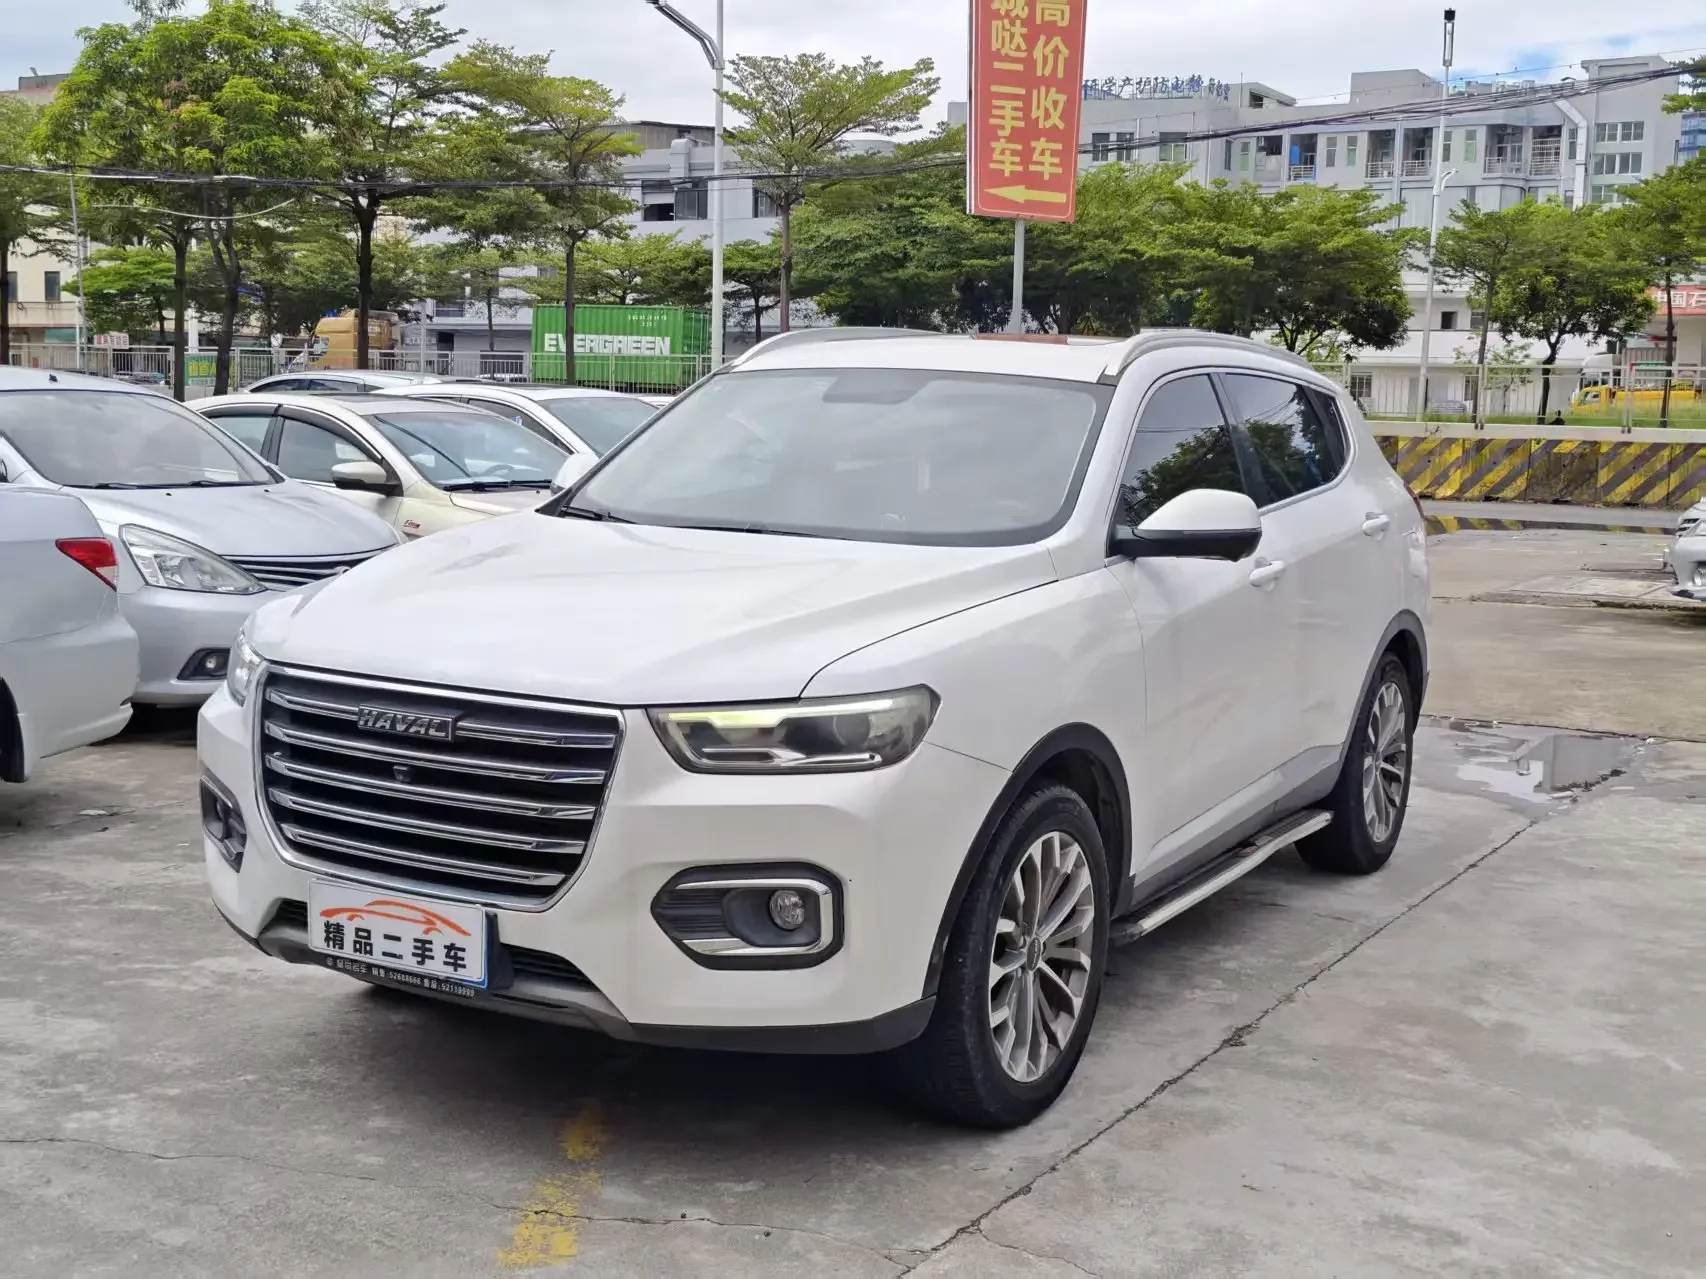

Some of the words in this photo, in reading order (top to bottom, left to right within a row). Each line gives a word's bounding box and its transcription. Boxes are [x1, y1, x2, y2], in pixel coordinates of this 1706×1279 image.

[1029, 0, 1071, 180] 高价收车
[544, 333, 671, 355] EVERGREEN
[360, 709, 446, 737] HAVAL
[323, 920, 467, 972] 精品二手车
